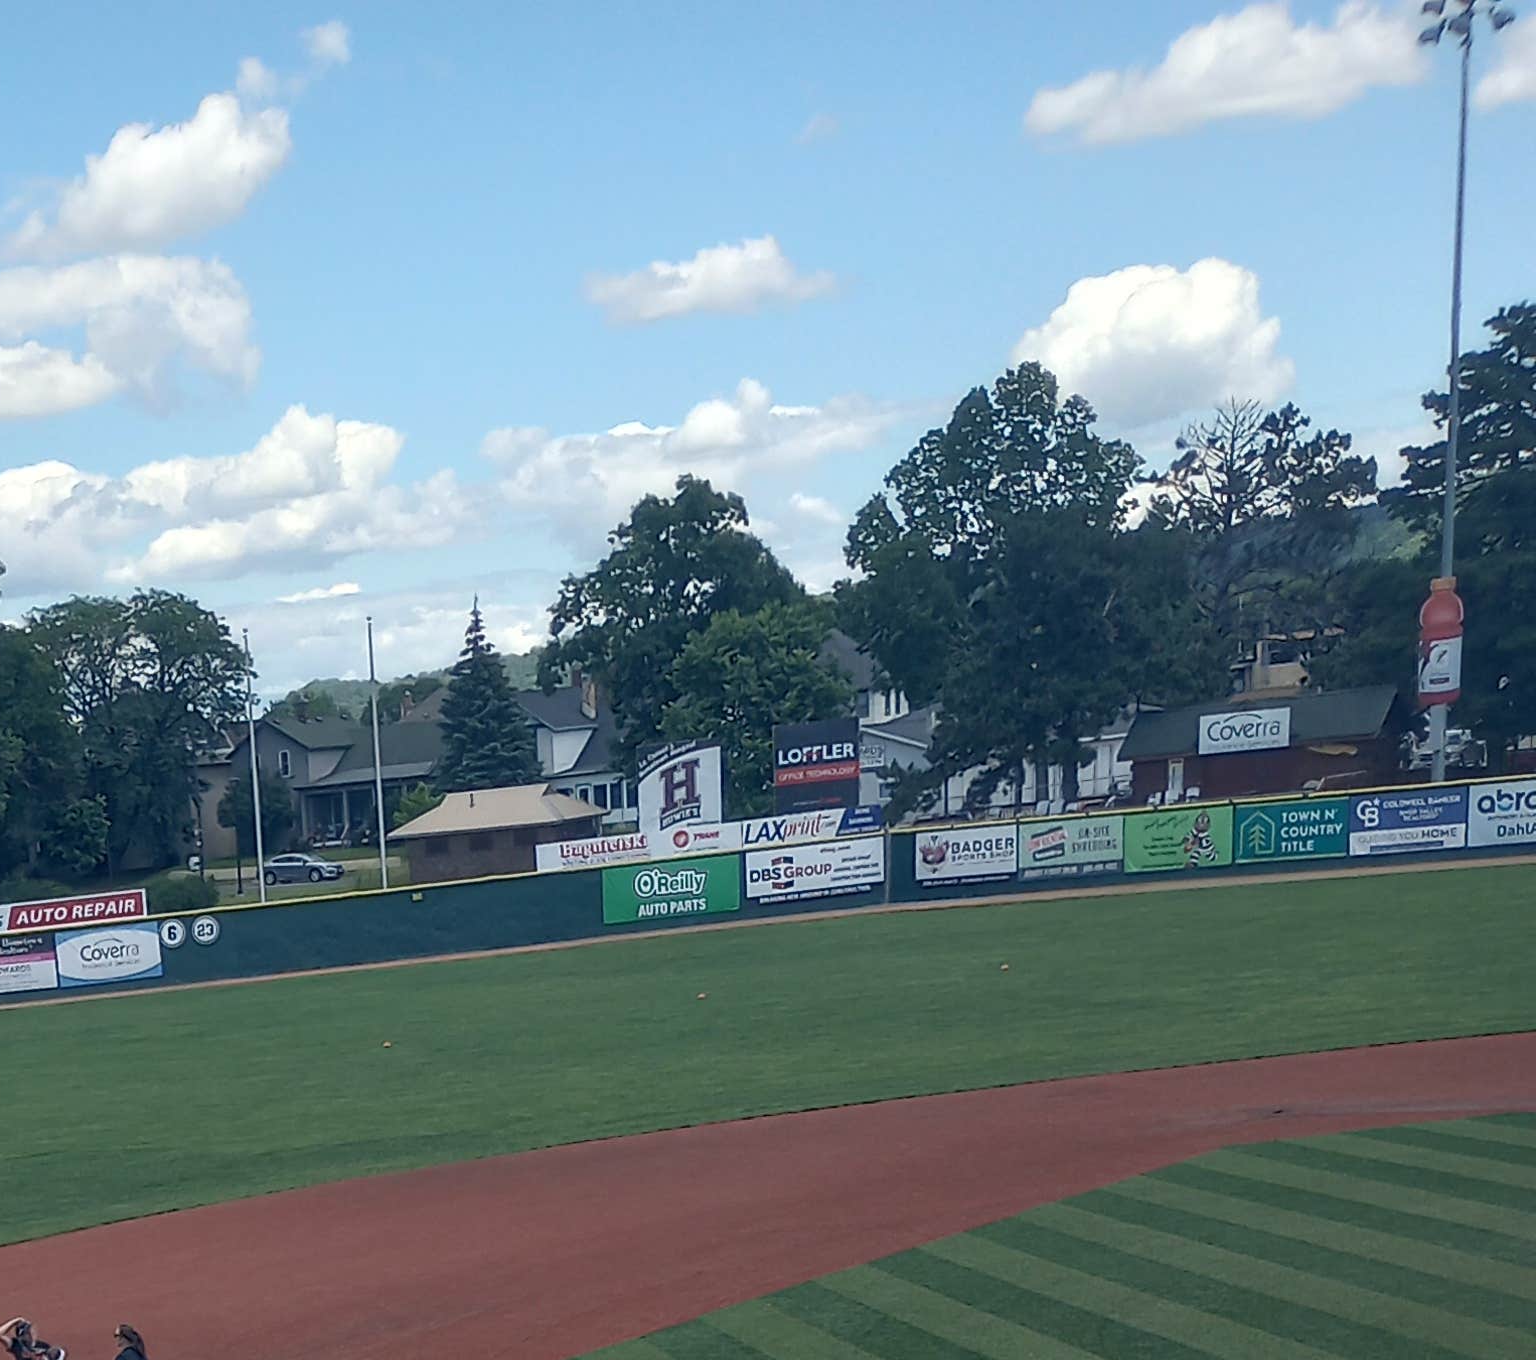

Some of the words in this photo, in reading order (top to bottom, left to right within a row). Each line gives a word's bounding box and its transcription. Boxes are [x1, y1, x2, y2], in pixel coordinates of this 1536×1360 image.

[1207, 715, 1281, 740] Coverra
[777, 743, 855, 766] LOFFLER
[659, 759, 700, 814] H
[1282, 810, 1321, 823] TOWN
[1280, 823, 1343, 839] COUNTRY
[1421, 828, 1457, 838] HOME
[951, 837, 1014, 855] BADGER
[1280, 839, 1315, 853] TITLE
[951, 853, 986, 863] SPORTS
[750, 868, 782, 884] DBS
[783, 863, 832, 879] GROUP
[634, 868, 708, 899] O'Reilly
[16, 907, 69, 925] AUTO
[71, 899, 136, 920] REPAIR
[638, 901, 668, 918] AUTO
[669, 898, 706, 915] PARTS
[167, 925, 177, 941] 6
[196, 922, 214, 937] 23
[79, 941, 140, 963] Coverra
